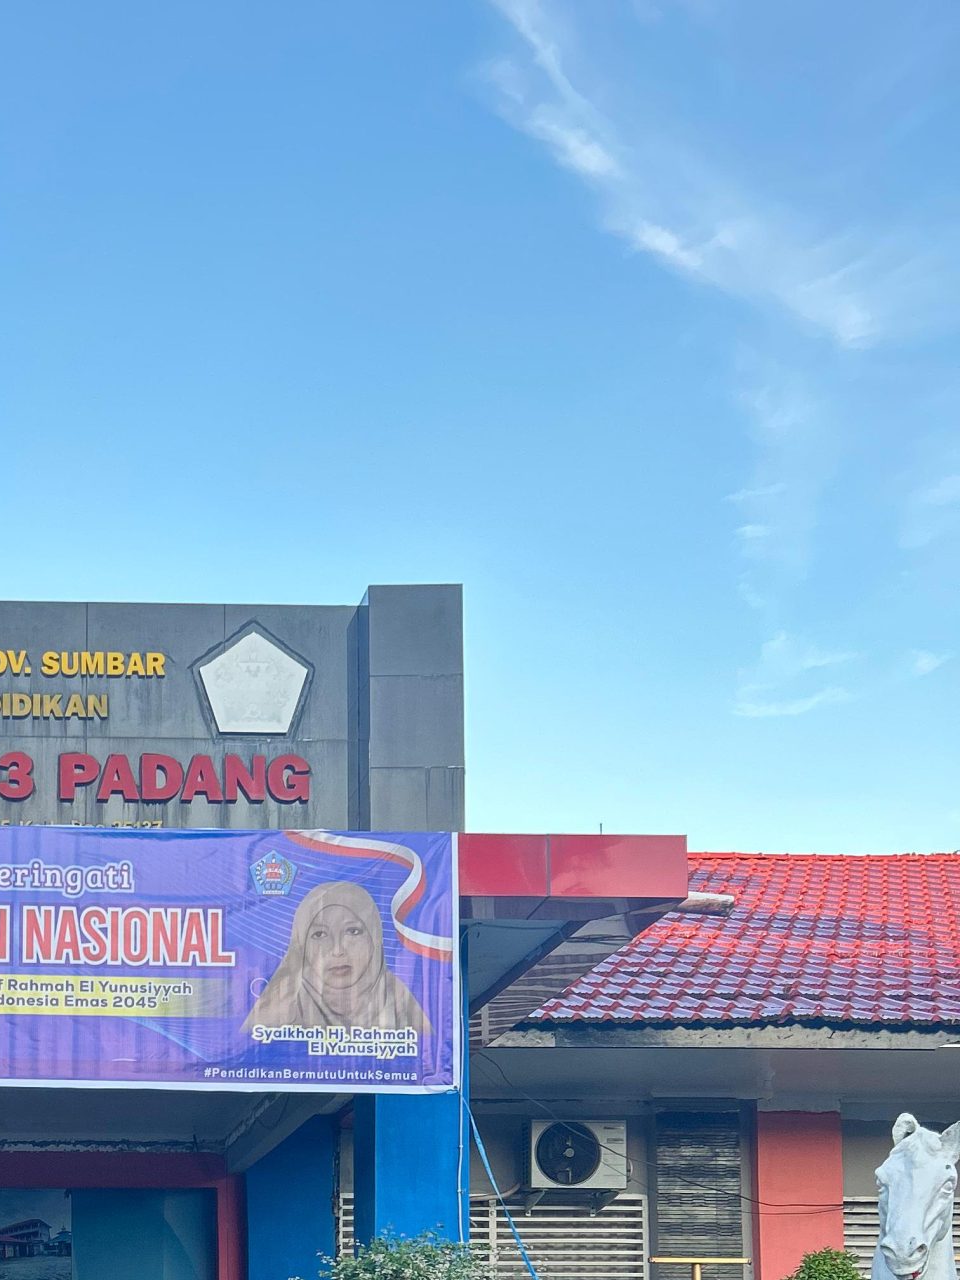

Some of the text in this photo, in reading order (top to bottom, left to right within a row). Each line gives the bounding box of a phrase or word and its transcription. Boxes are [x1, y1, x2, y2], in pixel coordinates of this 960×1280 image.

[41, 651, 166, 677] SUMBAR
[58, 753, 311, 805] PADANG
[24, 906, 234, 966] NASIONAL
[7, 979, 75, 993] Rahmah
[80, 981, 94, 993] El
[98, 981, 192, 997] Yunusiyyah
[64, 996, 108, 1008] Emas
[113, 996, 157, 1009] 2045
[254, 1027, 416, 1042] Syaikhah Hj. Rahmah
[311, 1042, 416, 1057] El Yunusiyyah
[204, 1067, 418, 1081] #PendidikanBermutuUntukSemua
